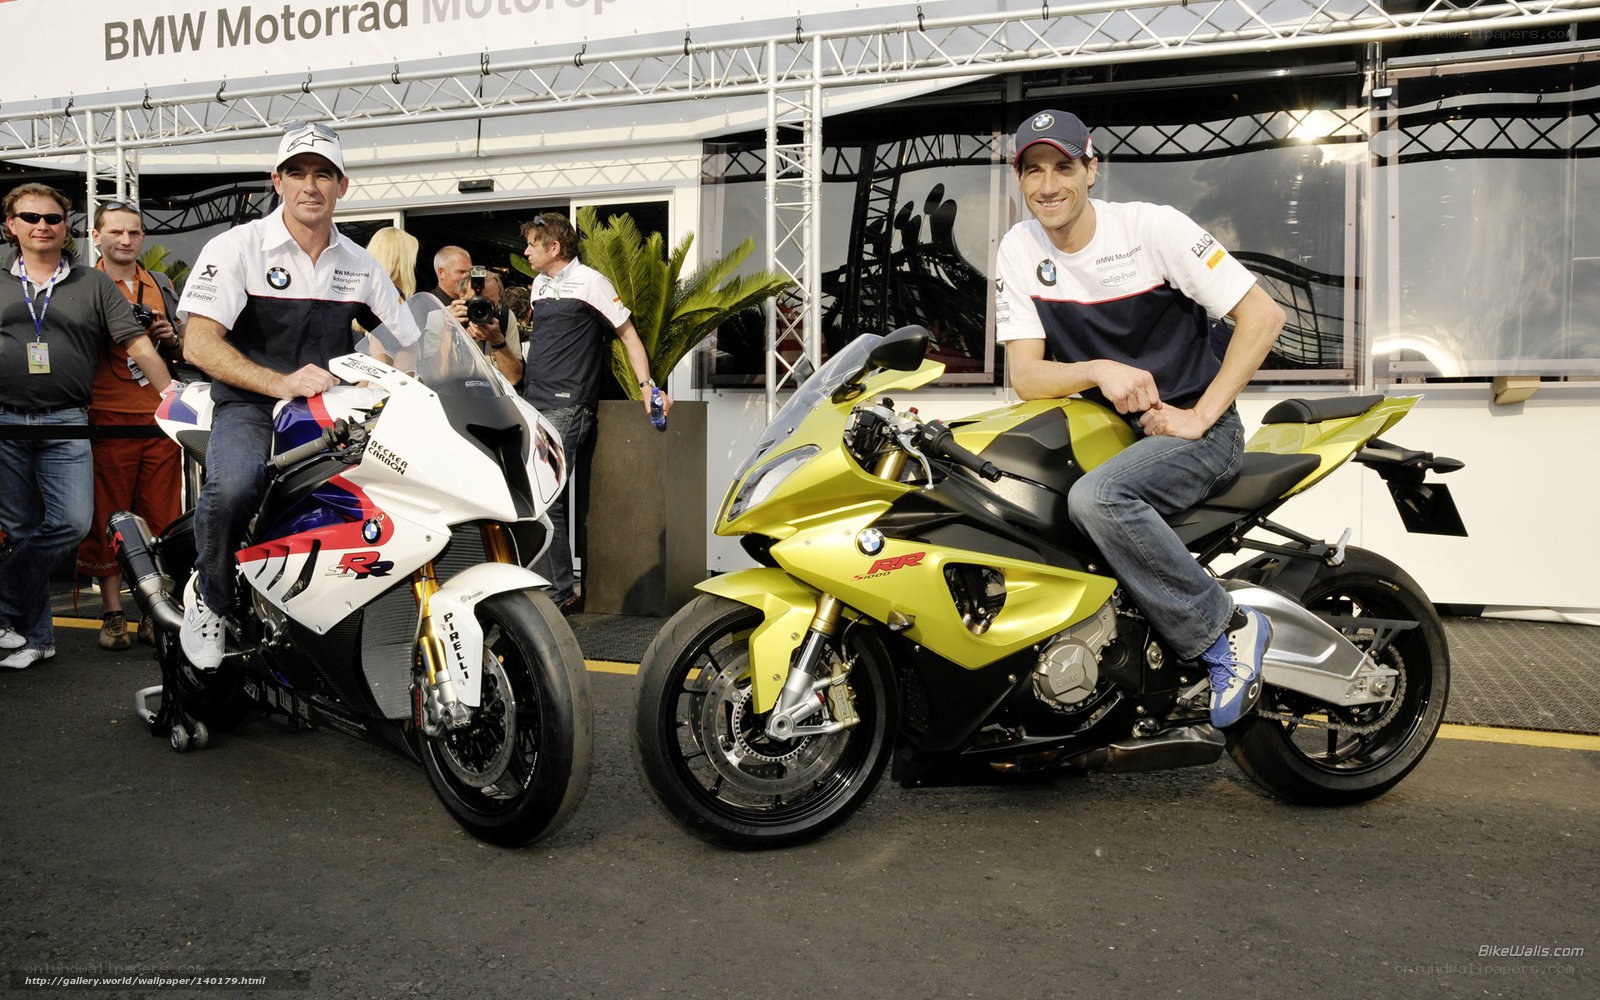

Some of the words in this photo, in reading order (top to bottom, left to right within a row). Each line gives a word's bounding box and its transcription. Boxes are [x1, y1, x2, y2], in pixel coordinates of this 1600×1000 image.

[104, 11, 207, 61] BMW
[216, 0, 408, 49] Motorrad
[1095, 254, 1115, 266] BMW
[368, 447, 405, 475] CARBON
[370, 440, 408, 469] BECKER
[867, 552, 926, 574] RR
[443, 612, 469, 680] PIRELLI
